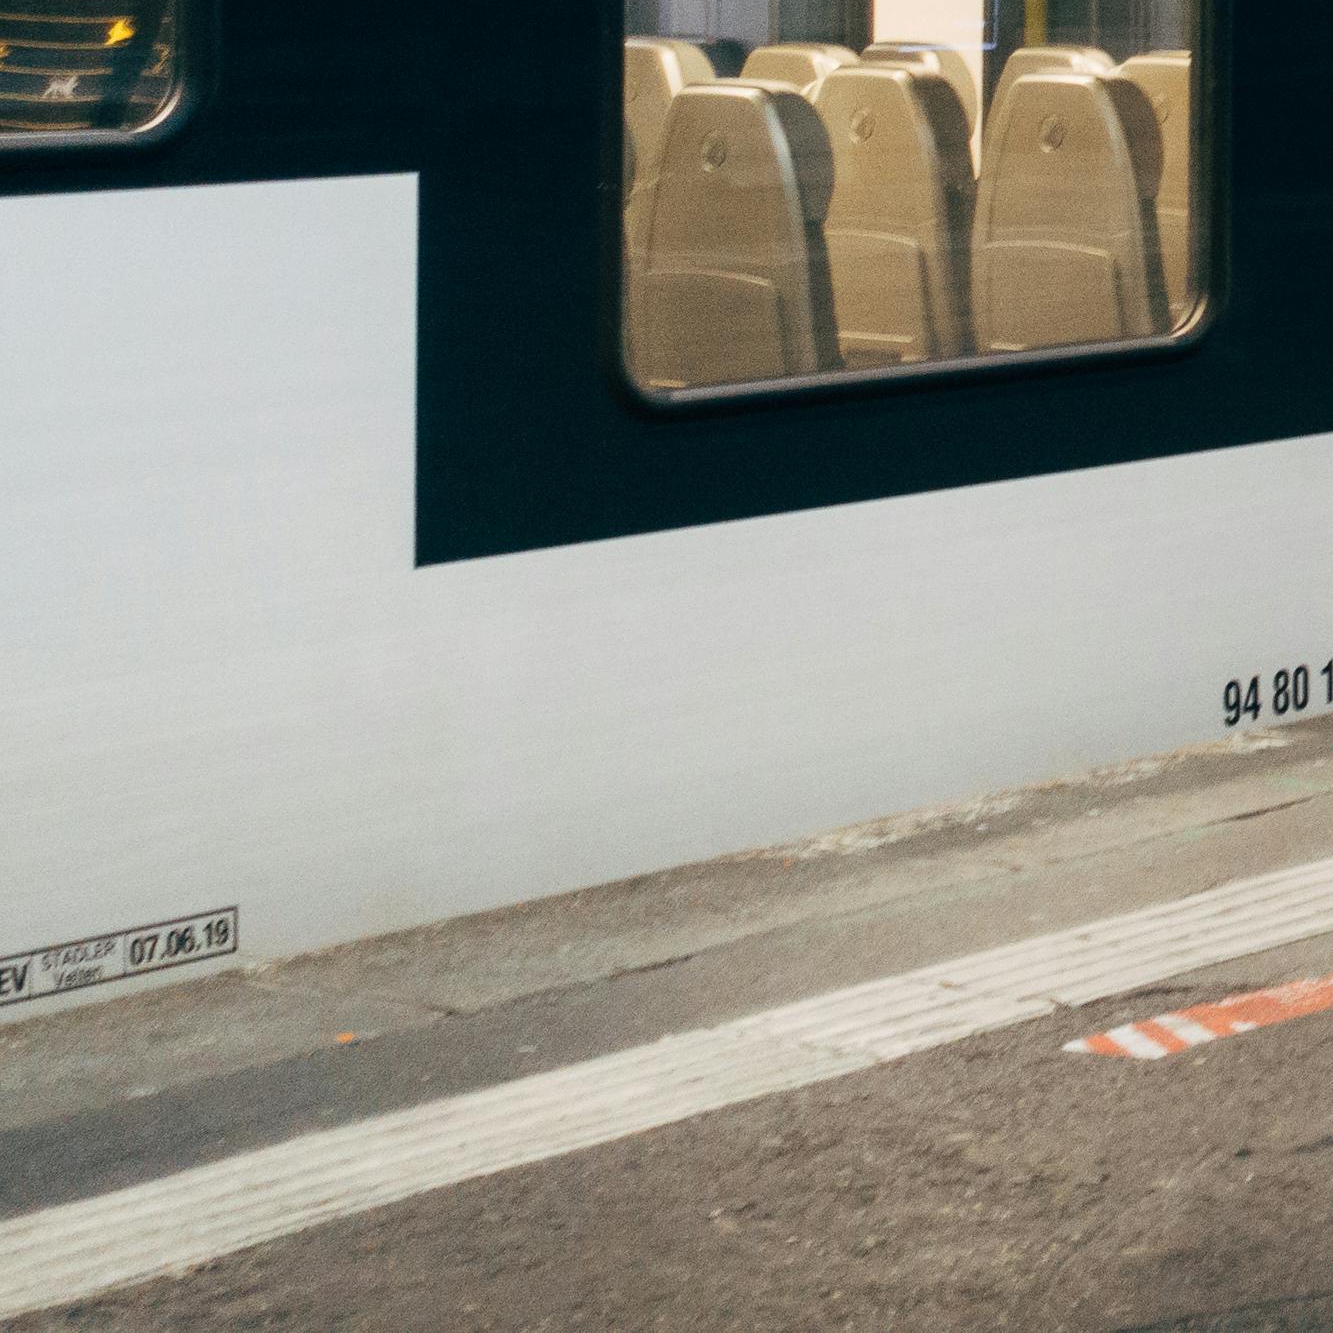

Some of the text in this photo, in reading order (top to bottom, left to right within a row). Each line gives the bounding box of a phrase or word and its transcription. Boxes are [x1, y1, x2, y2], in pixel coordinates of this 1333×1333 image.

[1223, 673, 1261, 726] 94
[1273, 665, 1309, 715] 80
[130, 918, 229, 966] 07.06.19
